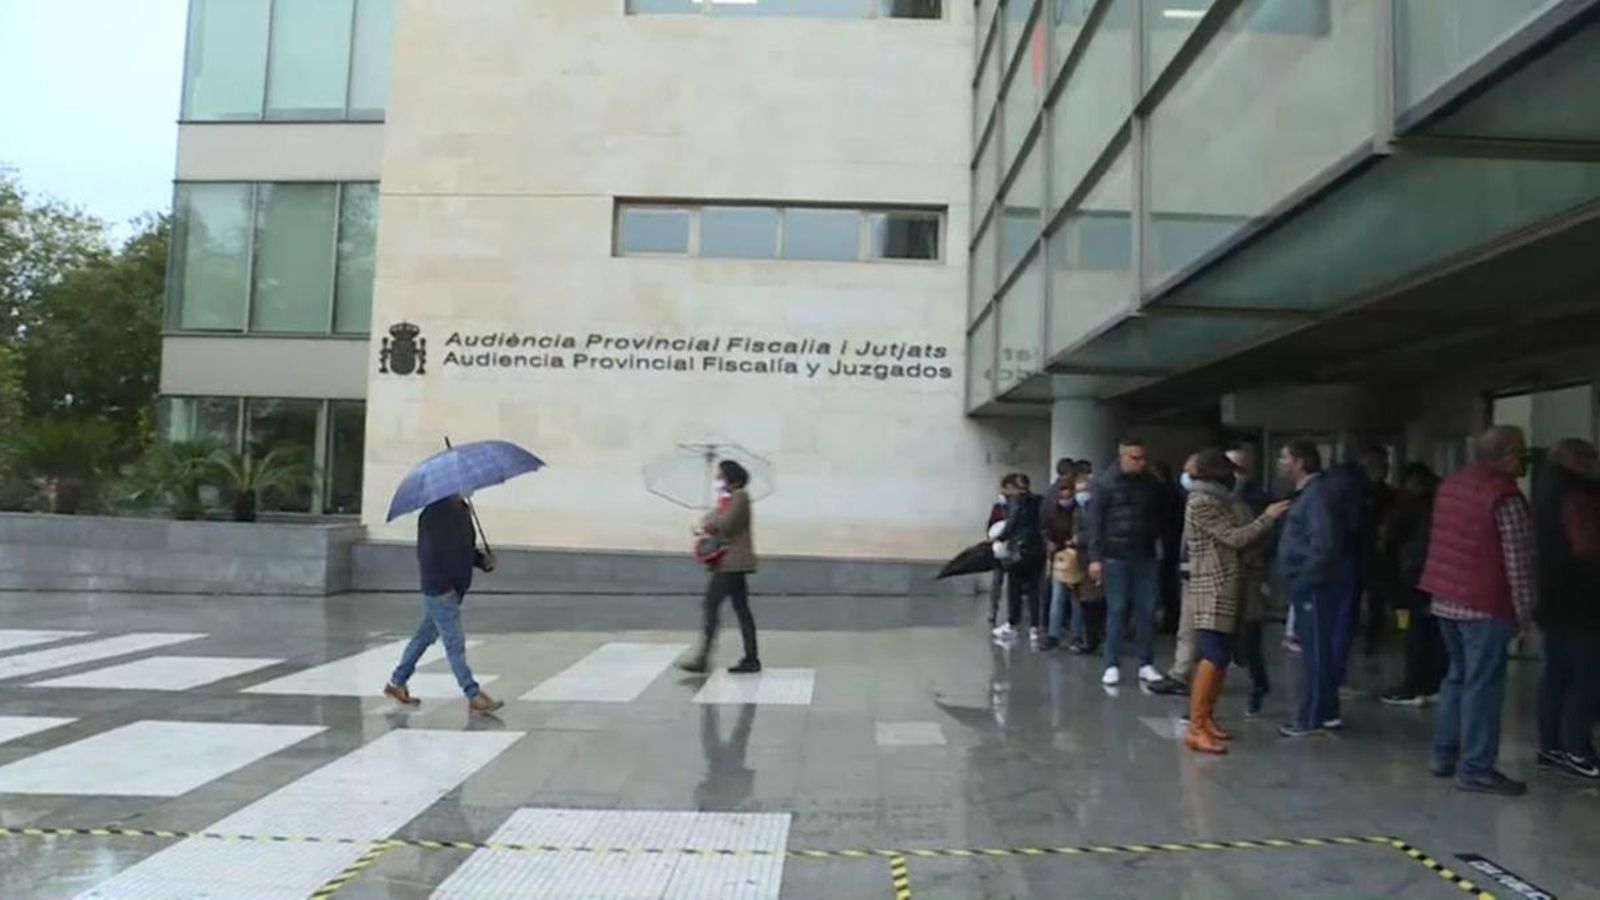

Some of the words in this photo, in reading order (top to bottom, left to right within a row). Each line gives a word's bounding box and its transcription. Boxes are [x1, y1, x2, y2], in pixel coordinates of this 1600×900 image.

[585, 335, 719, 352] Provincial
[727, 337, 831, 354] Fiscalia
[855, 341, 948, 360] Jutjats
[443, 351, 564, 368] Audiencia
[573, 354, 695, 371] Provincial
[702, 356, 798, 374] Fiscalía
[806, 361, 821, 378] y
[828, 360, 953, 381] Juzgados
